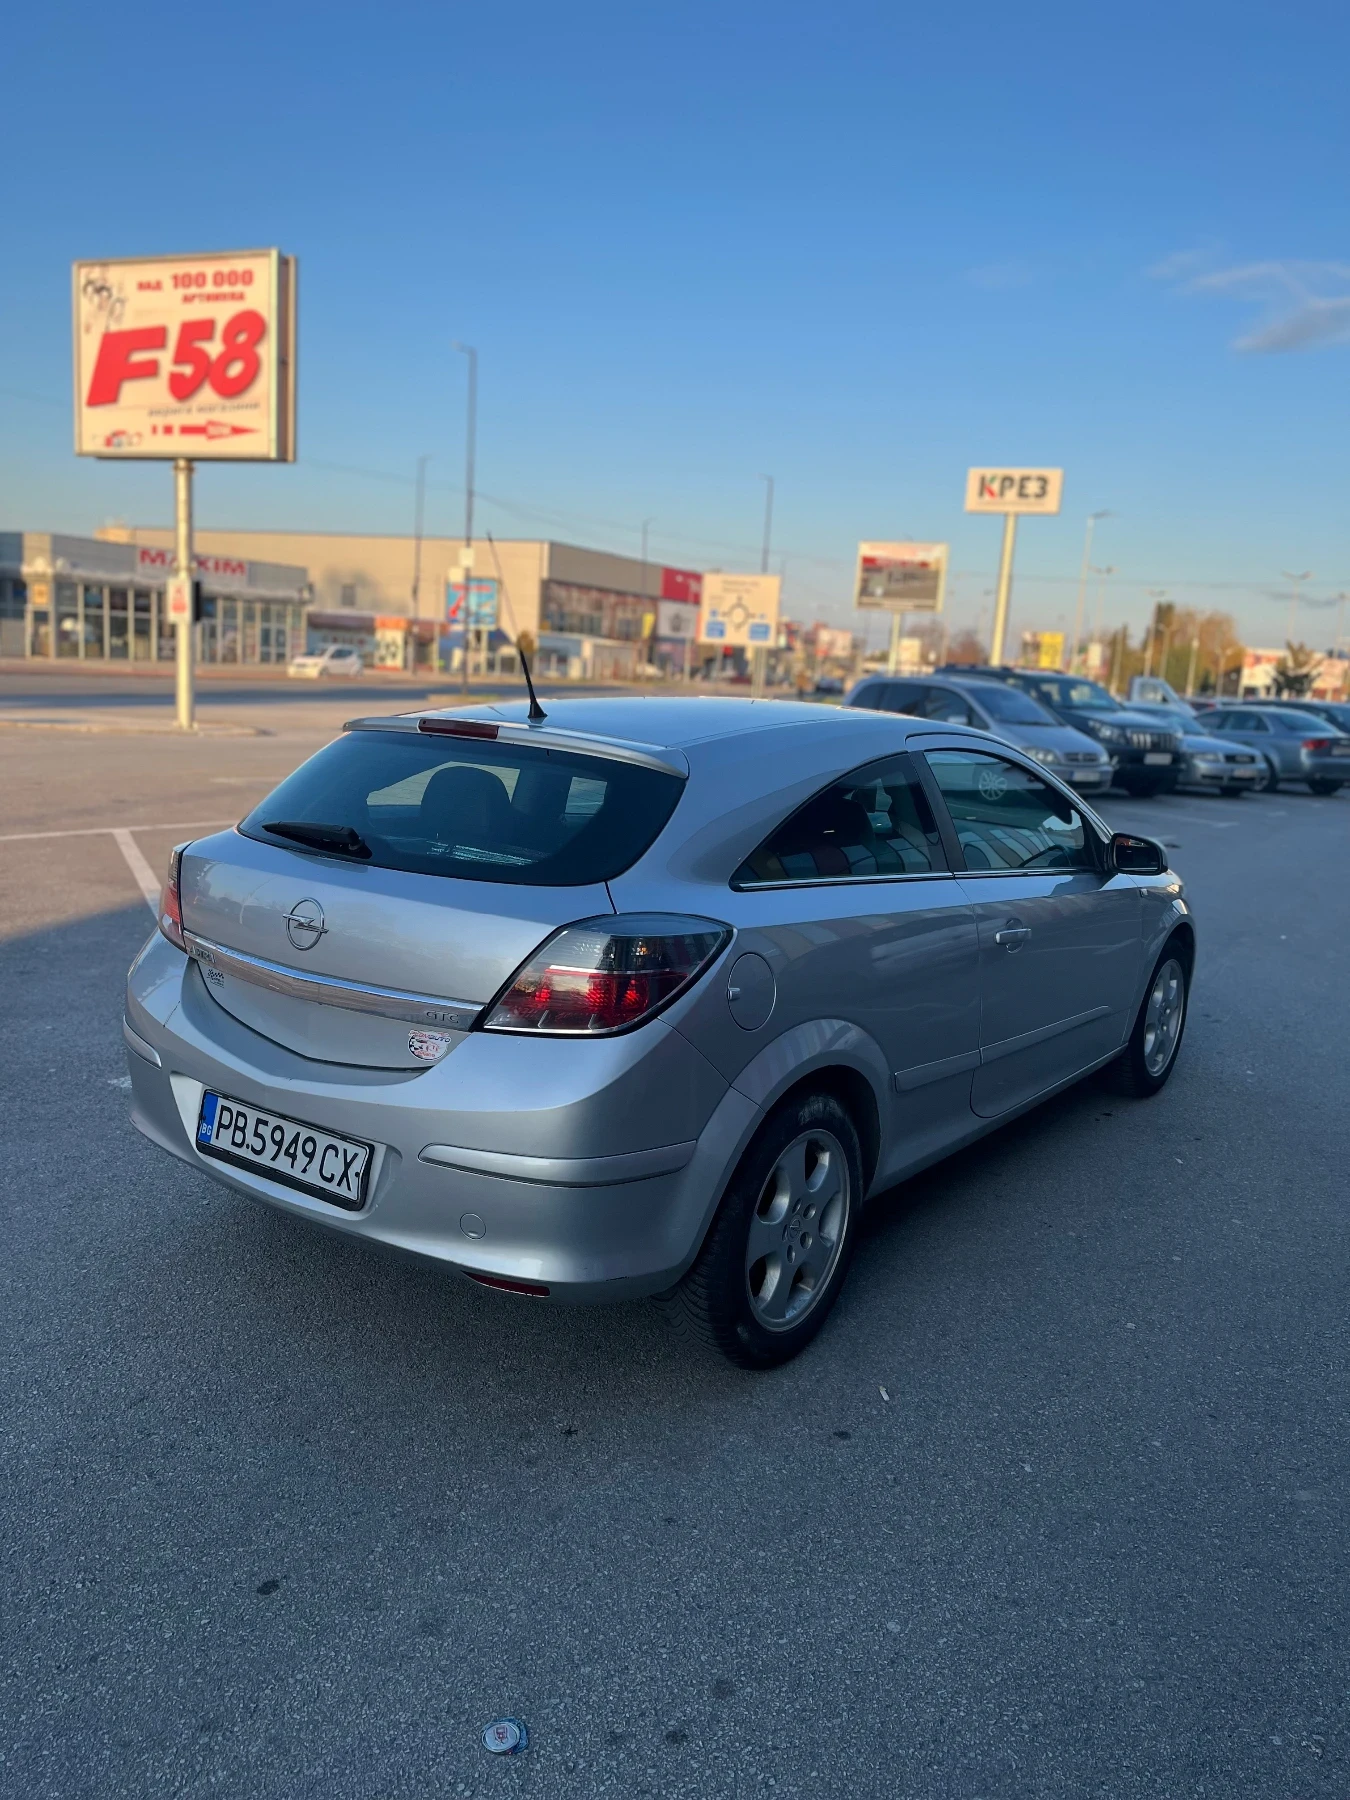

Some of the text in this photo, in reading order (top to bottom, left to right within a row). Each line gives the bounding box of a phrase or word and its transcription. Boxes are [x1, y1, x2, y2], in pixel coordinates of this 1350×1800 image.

[172, 272, 206, 289] 100
[213, 269, 254, 287] 000
[86, 309, 266, 407] F58
[978, 474, 1048, 499] КРЕЗ
[201, 1122, 212, 1135] BG
